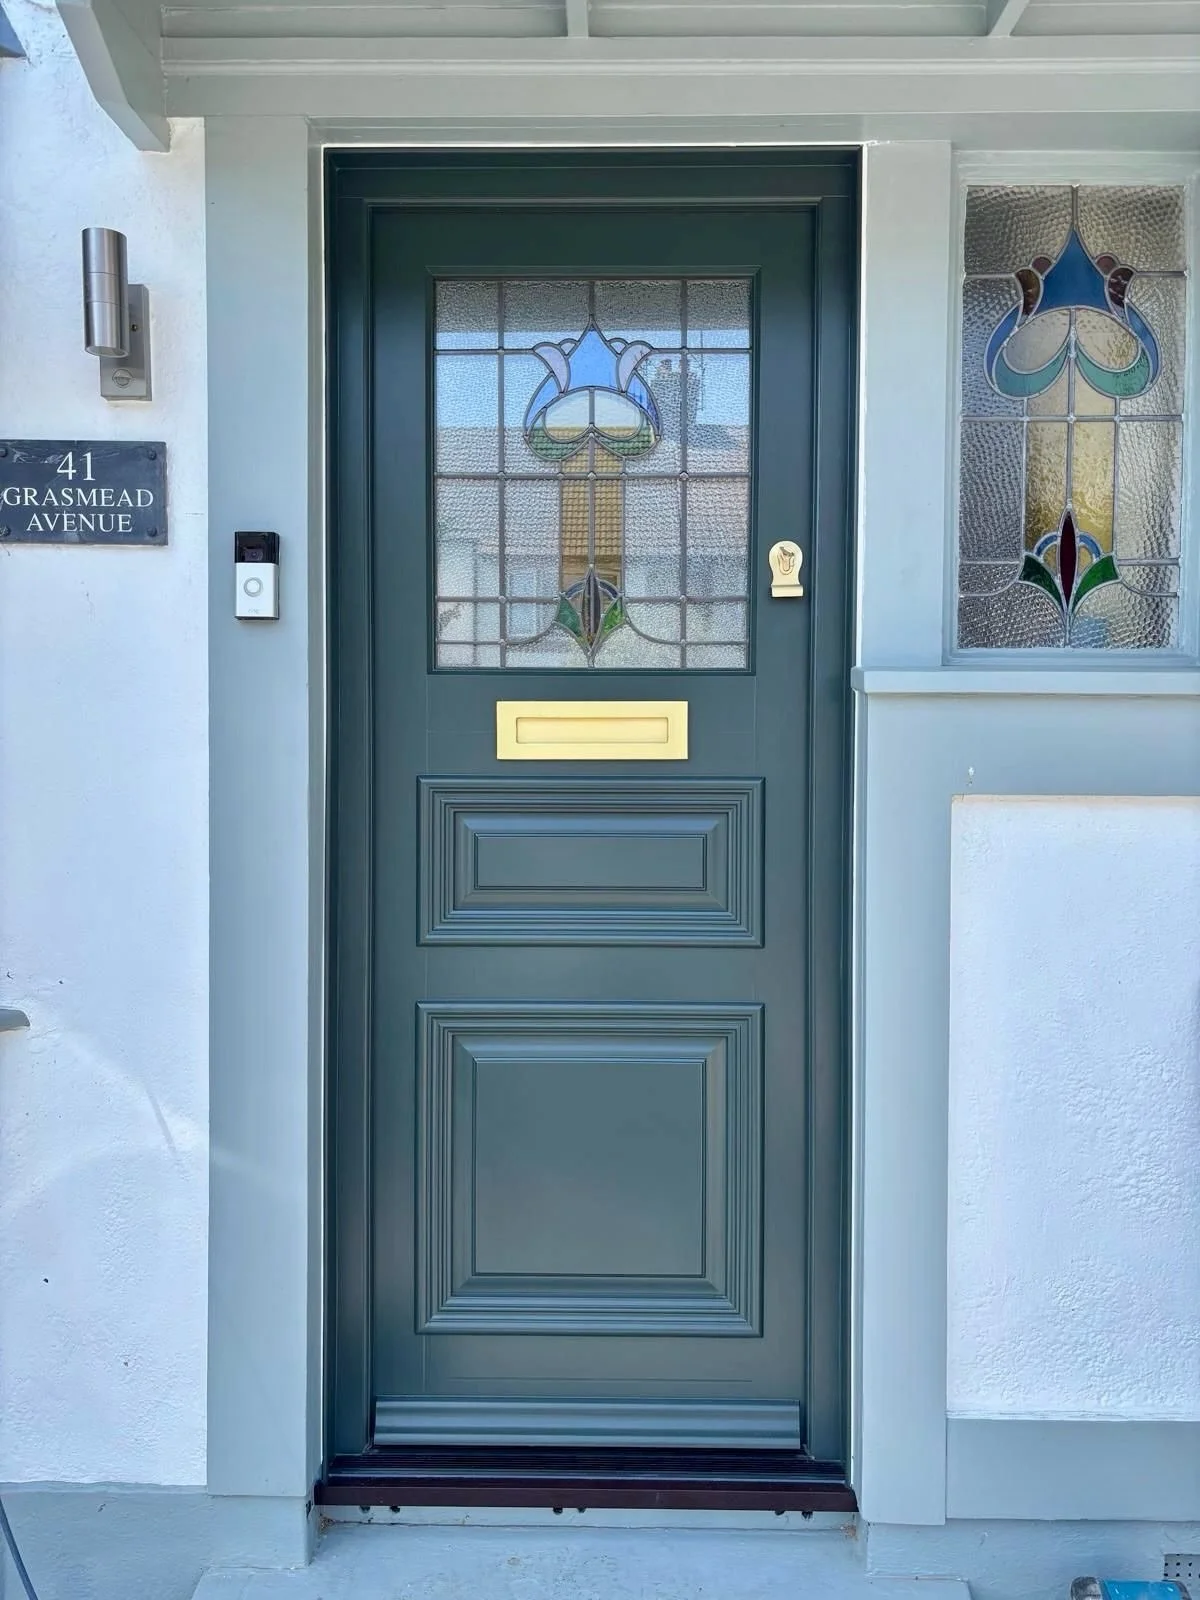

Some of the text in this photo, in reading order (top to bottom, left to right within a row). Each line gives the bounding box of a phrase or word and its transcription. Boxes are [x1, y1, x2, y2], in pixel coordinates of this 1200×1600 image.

[56, 451, 96, 481] 41
[3, 487, 154, 507] GRASMEAD
[26, 513, 133, 533] AVENUE
